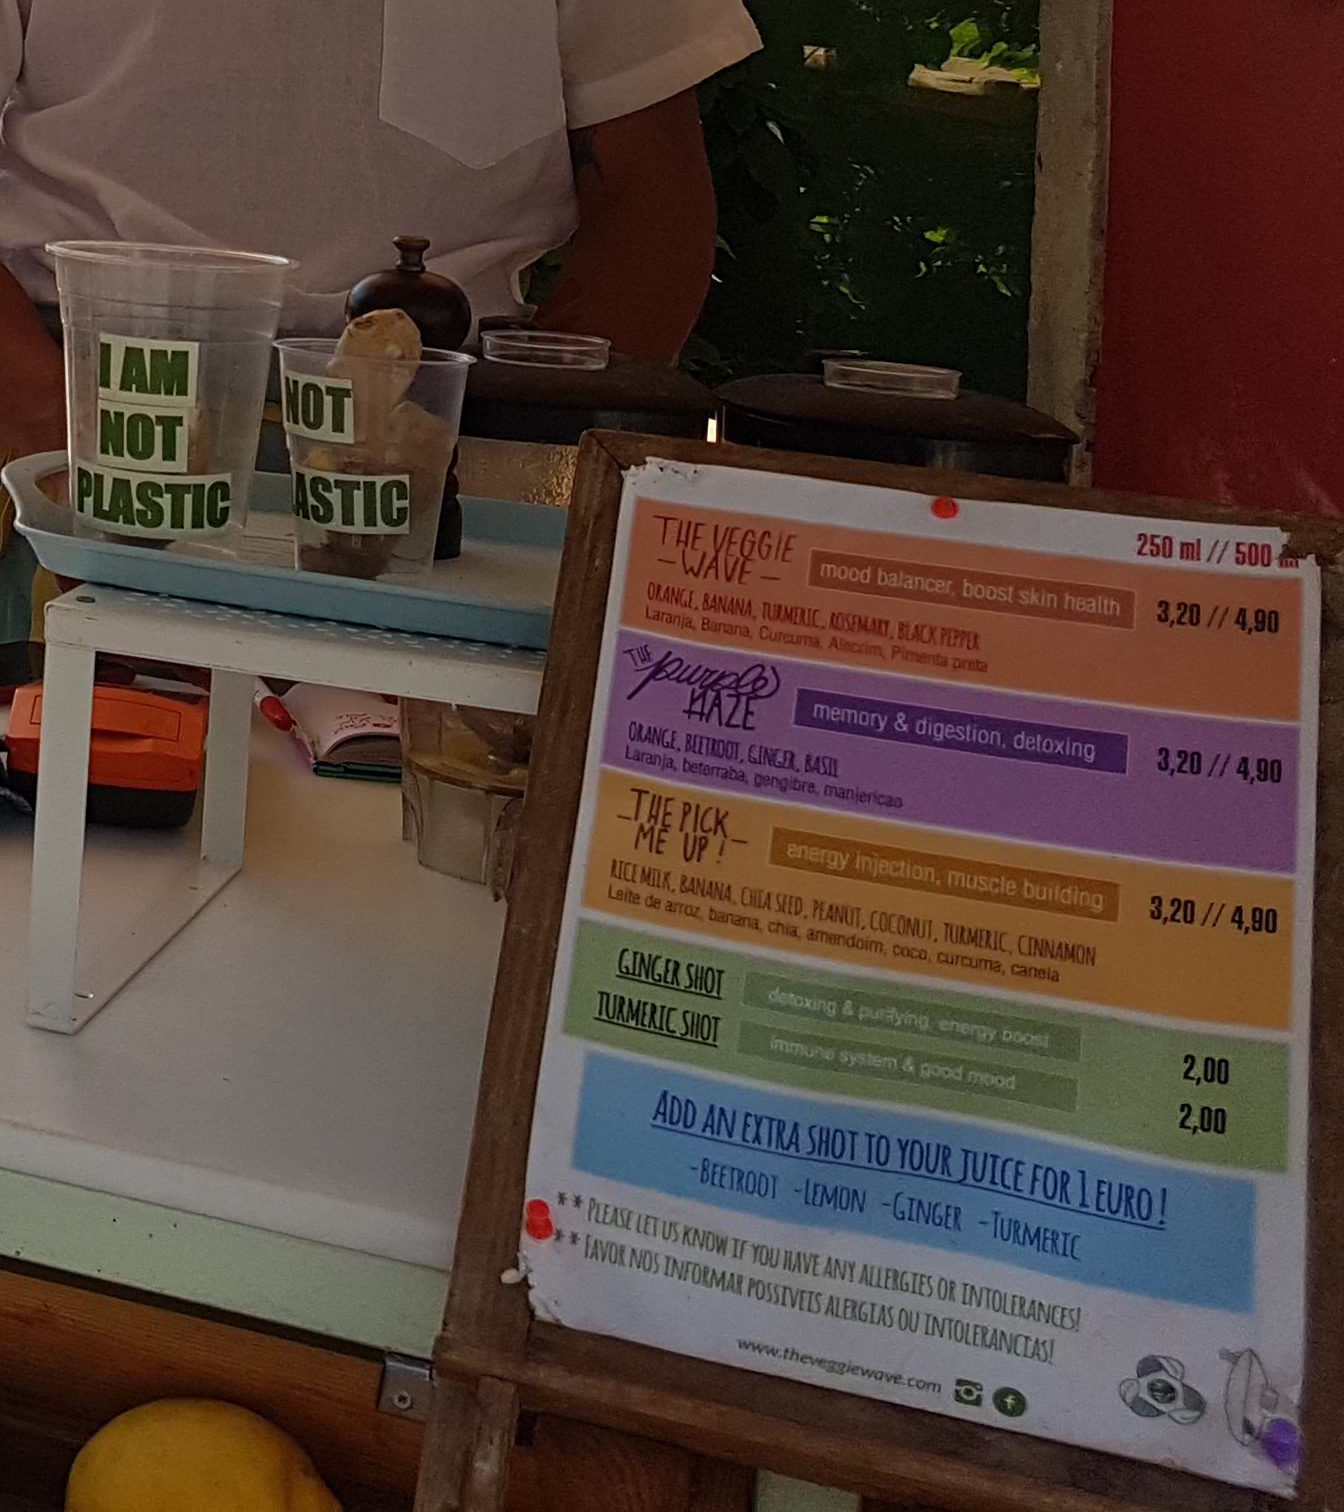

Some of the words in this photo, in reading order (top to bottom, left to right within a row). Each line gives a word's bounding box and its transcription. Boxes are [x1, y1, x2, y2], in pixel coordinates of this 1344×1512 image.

[99, 342, 112, 389] I
[119, 345, 190, 397] AM
[285, 376, 352, 434] NOT
[99, 408, 184, 462] NOT
[77, 465, 232, 529] PLASTIC
[293, 470, 409, 528] ASTIC
[653, 515, 706, 551] THE
[714, 524, 797, 562] VEGGIE
[1137, 533, 1173, 558] 250
[1179, 538, 1201, 561] ml
[1235, 541, 1271, 567] 500
[681, 549, 754, 584] WAVE
[820, 562, 871, 584] mood
[878, 569, 956, 598] balancer,
[962, 578, 1014, 604] boost
[1018, 589, 1058, 609] skin
[1063, 593, 1121, 616] health
[647, 582, 698, 611] ORANGE,
[703, 591, 755, 620] BANANA,
[898, 620, 937, 647] BLACK
[940, 628, 980, 652] PEPPER
[1157, 600, 1200, 628] 3,20
[1235, 608, 1279, 634] 4,90
[624, 645, 651, 667] THE
[891, 645, 947, 668] Pimenta
[682, 688, 756, 730] HAZE
[812, 702, 888, 731] memory
[894, 712, 909, 732] &
[916, 716, 1006, 748] digestion,
[1014, 731, 1096, 763] detoxing
[625, 745, 677, 772] Laranja,
[629, 721, 681, 751] ORANGE,
[685, 734, 744, 763] BEETROOT,
[804, 754, 839, 778] BASIL
[1157, 747, 1202, 777] 3,20
[1236, 757, 1282, 785] 4,90
[631, 788, 674, 828] THE
[679, 801, 730, 838] PICK
[634, 823, 669, 855] ME
[786, 840, 850, 871] energy
[855, 849, 941, 886] injection,
[947, 869, 1017, 898] muscle
[1023, 877, 1105, 914] building
[607, 884, 642, 906] Leite
[645, 892, 661, 910] de
[937, 951, 1006, 976] curcuma,
[1011, 962, 1060, 983] canela
[610, 859, 638, 884] RICE
[640, 864, 676, 893] MILK,
[680, 874, 736, 905] BANANA,
[741, 886, 772, 912] CHIA
[774, 892, 808, 920] SEED,
[812, 899, 866, 930] PEANUT,
[870, 910, 938, 942] COCONUT,
[943, 922, 1013, 955] TURMERIC,
[1018, 934, 1098, 967] CINNAMON
[1149, 896, 1195, 925] 3,20
[1230, 905, 1278, 935] 4,90
[617, 947, 682, 987] GINGER
[683, 962, 725, 998] SHOT
[598, 990, 678, 1034] TURMERIC
[679, 1009, 722, 1045] SHOT
[841, 999, 854, 1016] &
[840, 1049, 898, 1070] system
[902, 1054, 914, 1072] &
[920, 1062, 962, 1080] good
[968, 1071, 1016, 1089] mood
[1182, 1054, 1229, 1086] 2,00
[1178, 1103, 1226, 1135] 2,00
[652, 1089, 697, 1129] ADD
[702, 1104, 736, 1138] AN
[741, 1111, 801, 1153] EXTRA
[805, 1124, 859, 1161] SHOT
[865, 1132, 891, 1167] TO
[897, 1138, 953, 1178] YOUR
[957, 1148, 1026, 1193] JUICE
[1029, 1163, 1071, 1206] FOR
[1078, 1169, 1090, 1209] 1
[587, 1197, 632, 1231] PLEASE
[635, 1213, 659, 1238] LET
[662, 1220, 679, 1242] US
[682, 1224, 728, 1258] KNOW
[732, 1237, 748, 1261] IF
[751, 1242, 780, 1269] YOU
[783, 1249, 820, 1277] HAVE
[824, 1256, 856, 1283] ANY
[861, 1263, 933, 1299] ALLERGIES
[937, 1276, 957, 1302] OR
[961, 1282, 1082, 1332] INTOLERANCES!
[584, 1234, 627, 1267] FAVOR
[629, 1247, 659, 1275] NOS
[663, 1255, 744, 1297] INFORMAR
[747, 1277, 822, 1316] POSSIVEIS
[824, 1294, 894, 1329] ALERGIAS
[898, 1307, 920, 1333] OU
[924, 1313, 1054, 1365] INTOLERANCIAS!
[736, 1338, 942, 1394] www.theveggiewave.com
